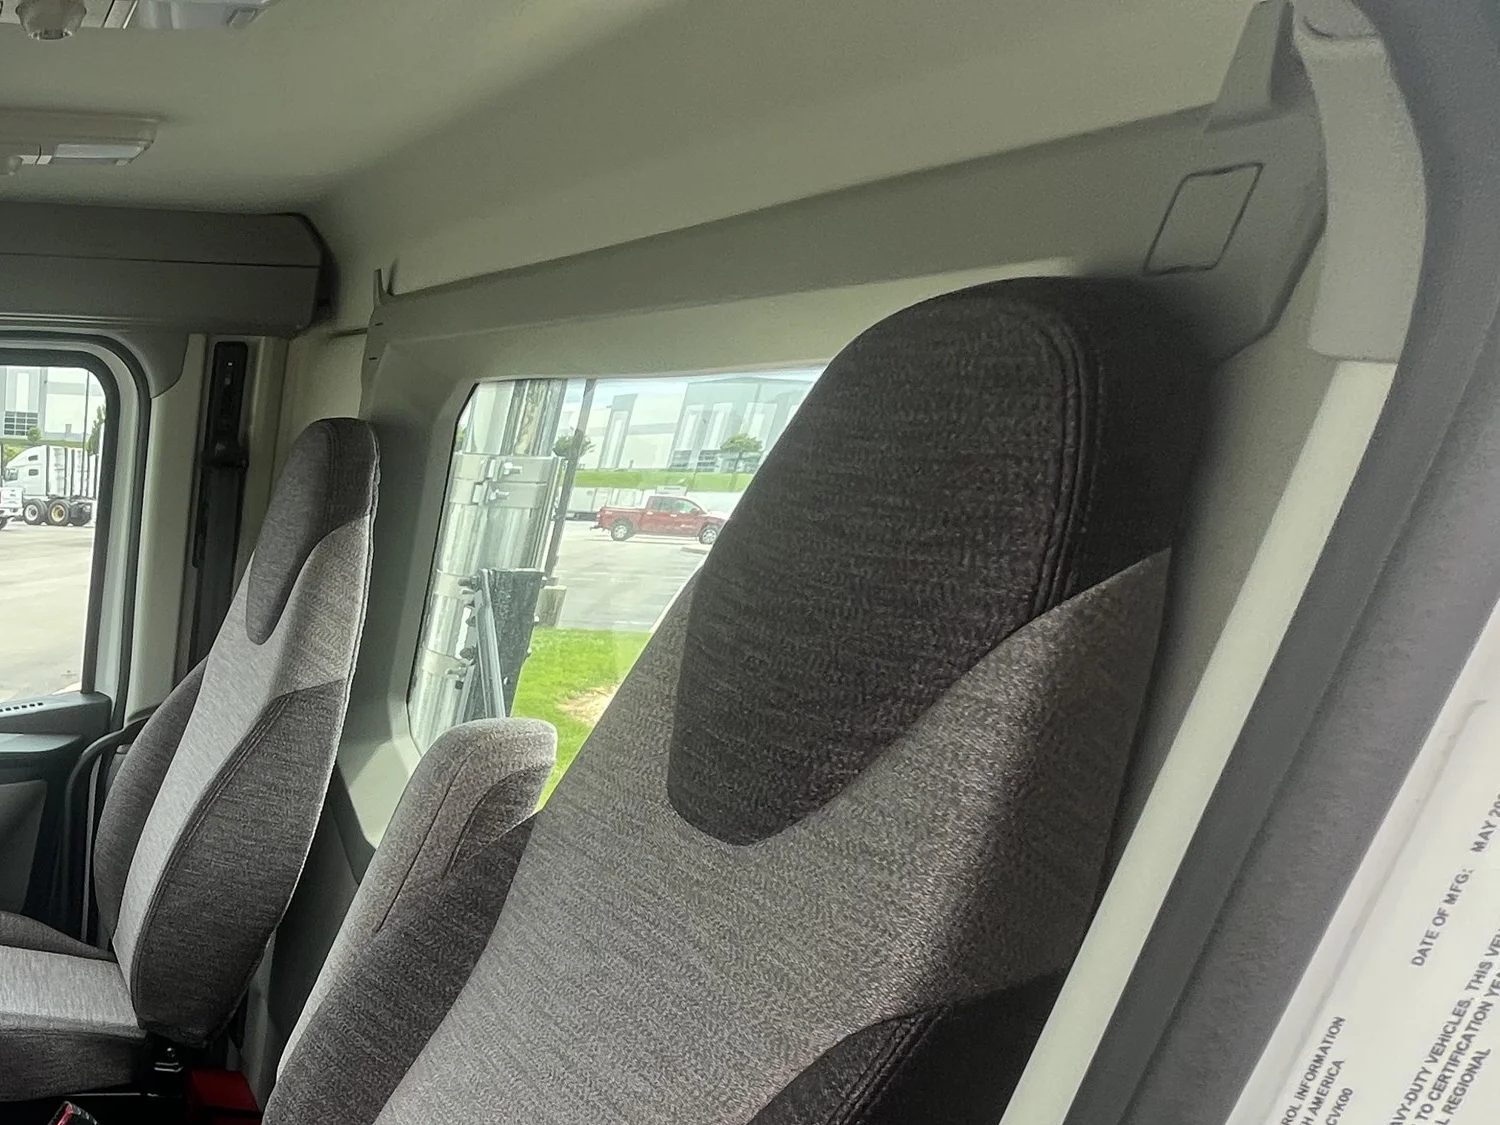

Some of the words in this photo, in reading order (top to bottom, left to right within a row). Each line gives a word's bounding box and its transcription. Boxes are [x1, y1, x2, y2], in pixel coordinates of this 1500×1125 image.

[1409, 928, 1440, 967] DATE
[1430, 908, 1451, 927] OF
[1442, 865, 1473, 906] MFG:
[1469, 820, 1497, 854] MAY
[1465, 960, 1494, 992] THIS
[1294, 1015, 1345, 1099] INFORMATION
[1306, 1057, 1344, 1114] AMERICA
[1415, 1103, 1434, 1121] TO
[1426, 1000, 1493, 1100] CERTIFICATION
[1441, 1046, 1491, 1113] REGIONAL
